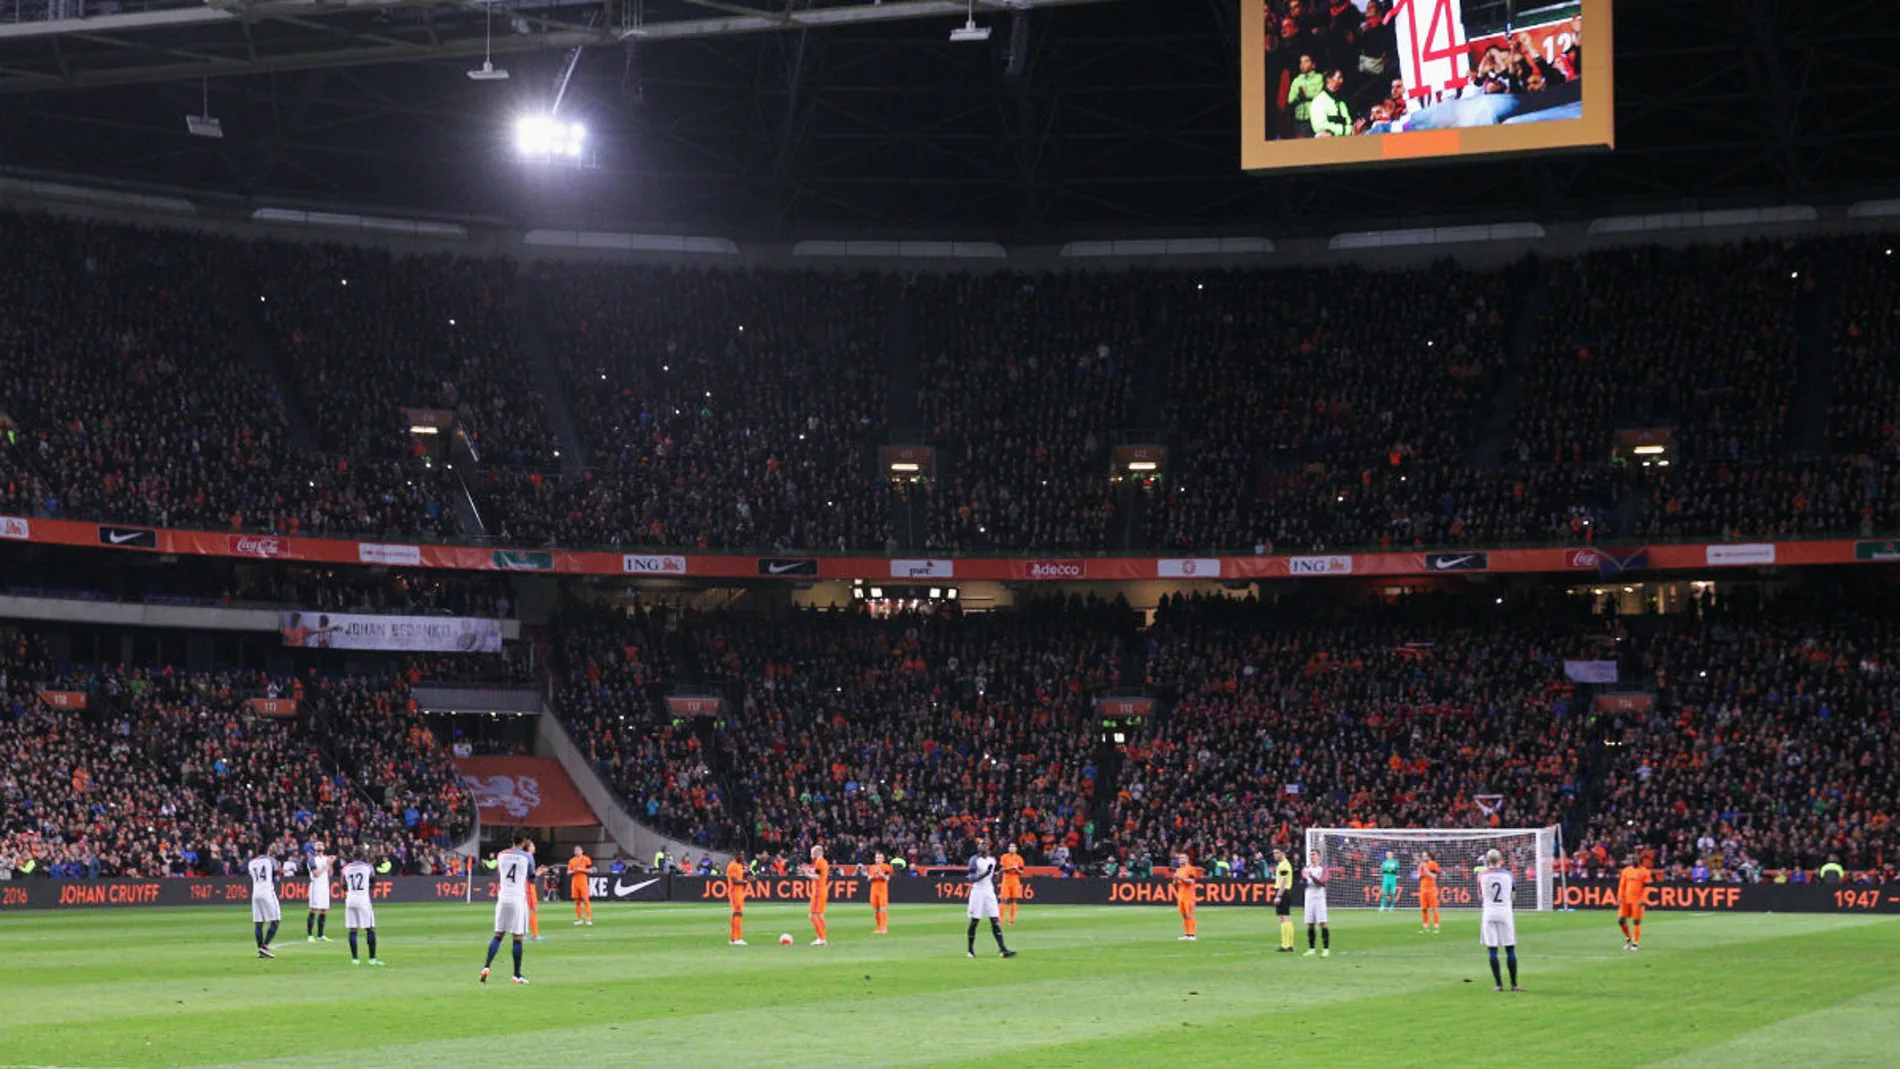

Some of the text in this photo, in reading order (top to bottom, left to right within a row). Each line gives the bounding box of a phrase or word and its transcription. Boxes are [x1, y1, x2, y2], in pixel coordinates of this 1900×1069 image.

[1383, 0, 1470, 99] 14
[628, 558, 658, 571] ING
[1032, 563, 1080, 575] Adecco
[1293, 560, 1325, 572] ING
[345, 622, 386, 635] JOHAN
[253, 865, 267, 881] 14
[350, 872, 364, 891] 12
[506, 863, 517, 883] 4
[3, 887, 28, 904] 2016
[59, 883, 160, 904] JOHAN CRUYFF
[190, 885, 212, 899] 1947
[225, 884, 248, 899] 2016
[279, 881, 310, 899] JOH
[435, 882, 468, 897] 1947
[702, 880, 771, 899] JOAN
[935, 883, 972, 899] 1947
[1109, 883, 1277, 902] JOHAN CRUYFF
[1363, 885, 1404, 902] 197
[1492, 882, 1503, 903] 2
[1553, 886, 1742, 908] JOHA CRUYFF
[1834, 889, 1880, 908] 1947
